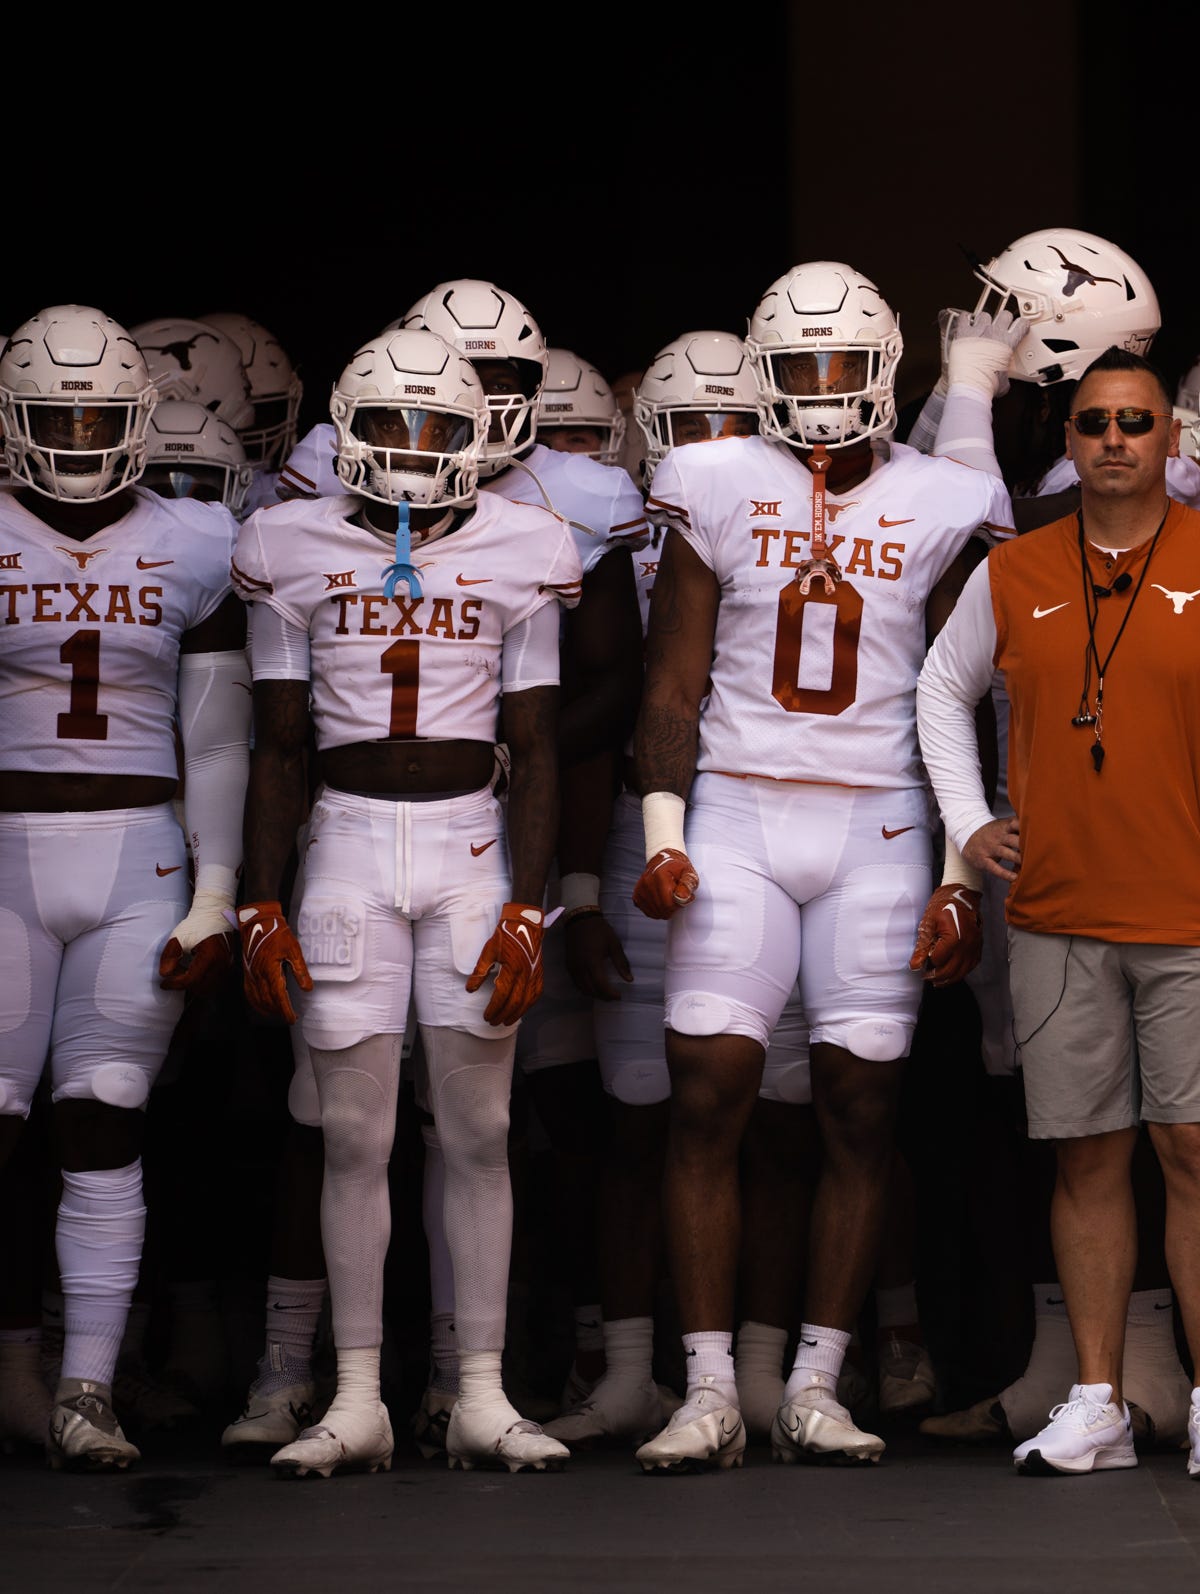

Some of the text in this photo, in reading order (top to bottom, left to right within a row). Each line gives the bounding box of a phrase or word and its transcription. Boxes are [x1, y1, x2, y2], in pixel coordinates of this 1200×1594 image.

[802, 327, 832, 337] HORNS
[465, 340, 496, 350] HORNS
[62, 381, 93, 391] HORNS
[404, 384, 436, 396] HORNS
[705, 384, 734, 396] HORNS
[545, 403, 573, 412] HORNS
[165, 443, 195, 452] HORNS
[750, 500, 781, 516] XII
[323, 570, 356, 590] XII
[0, 582, 162, 625] TEXAS
[334, 594, 482, 640] TEXAS
[771, 580, 863, 715] 0
[57, 630, 108, 740] 1
[380, 639, 427, 739] 1
